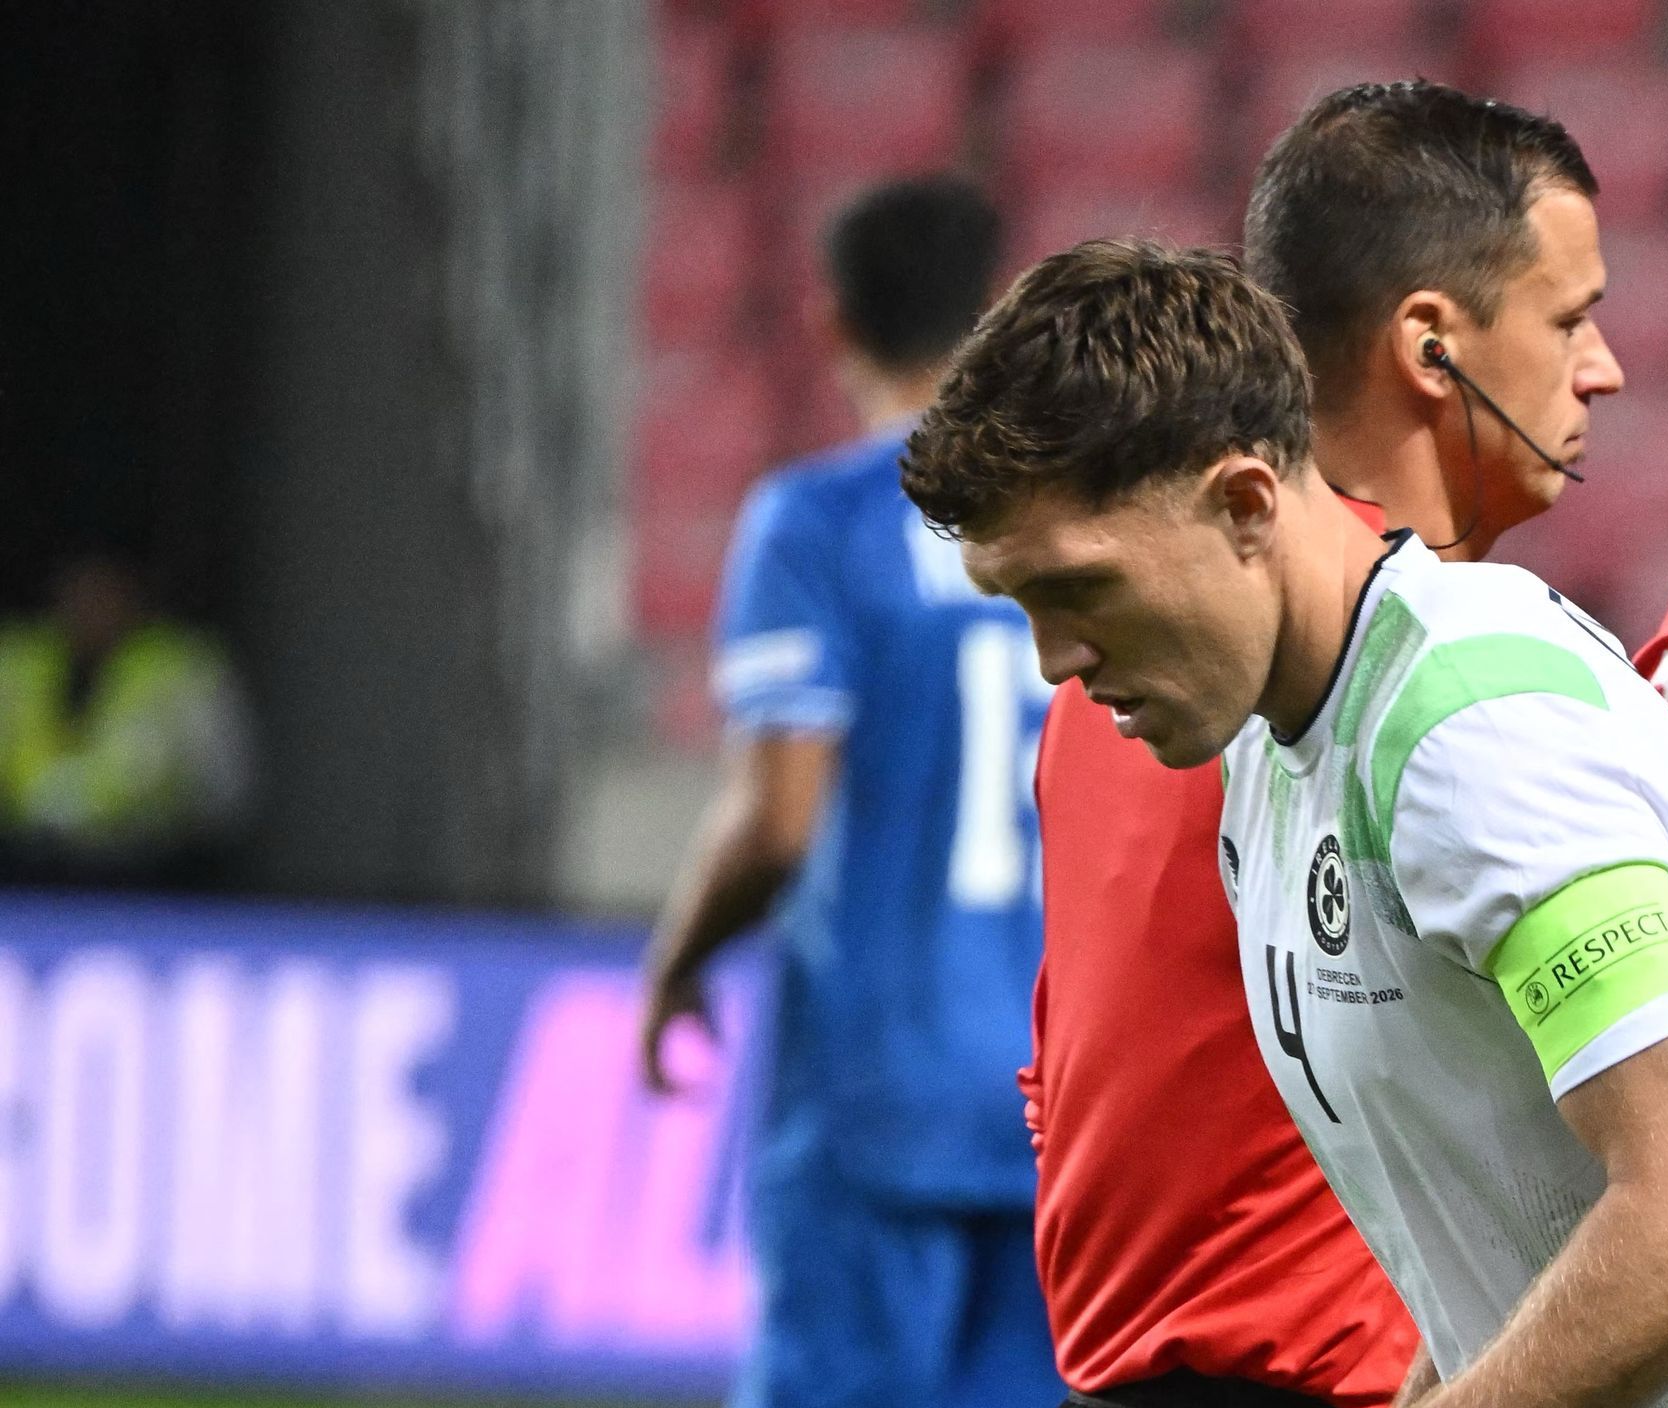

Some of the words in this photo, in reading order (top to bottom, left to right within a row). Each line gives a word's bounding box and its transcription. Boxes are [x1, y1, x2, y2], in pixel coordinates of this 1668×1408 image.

[1266, 943, 1343, 1124] 4
[1316, 986, 1369, 1005] SEPTEMBER
[1369, 988, 1404, 1005] 2026
